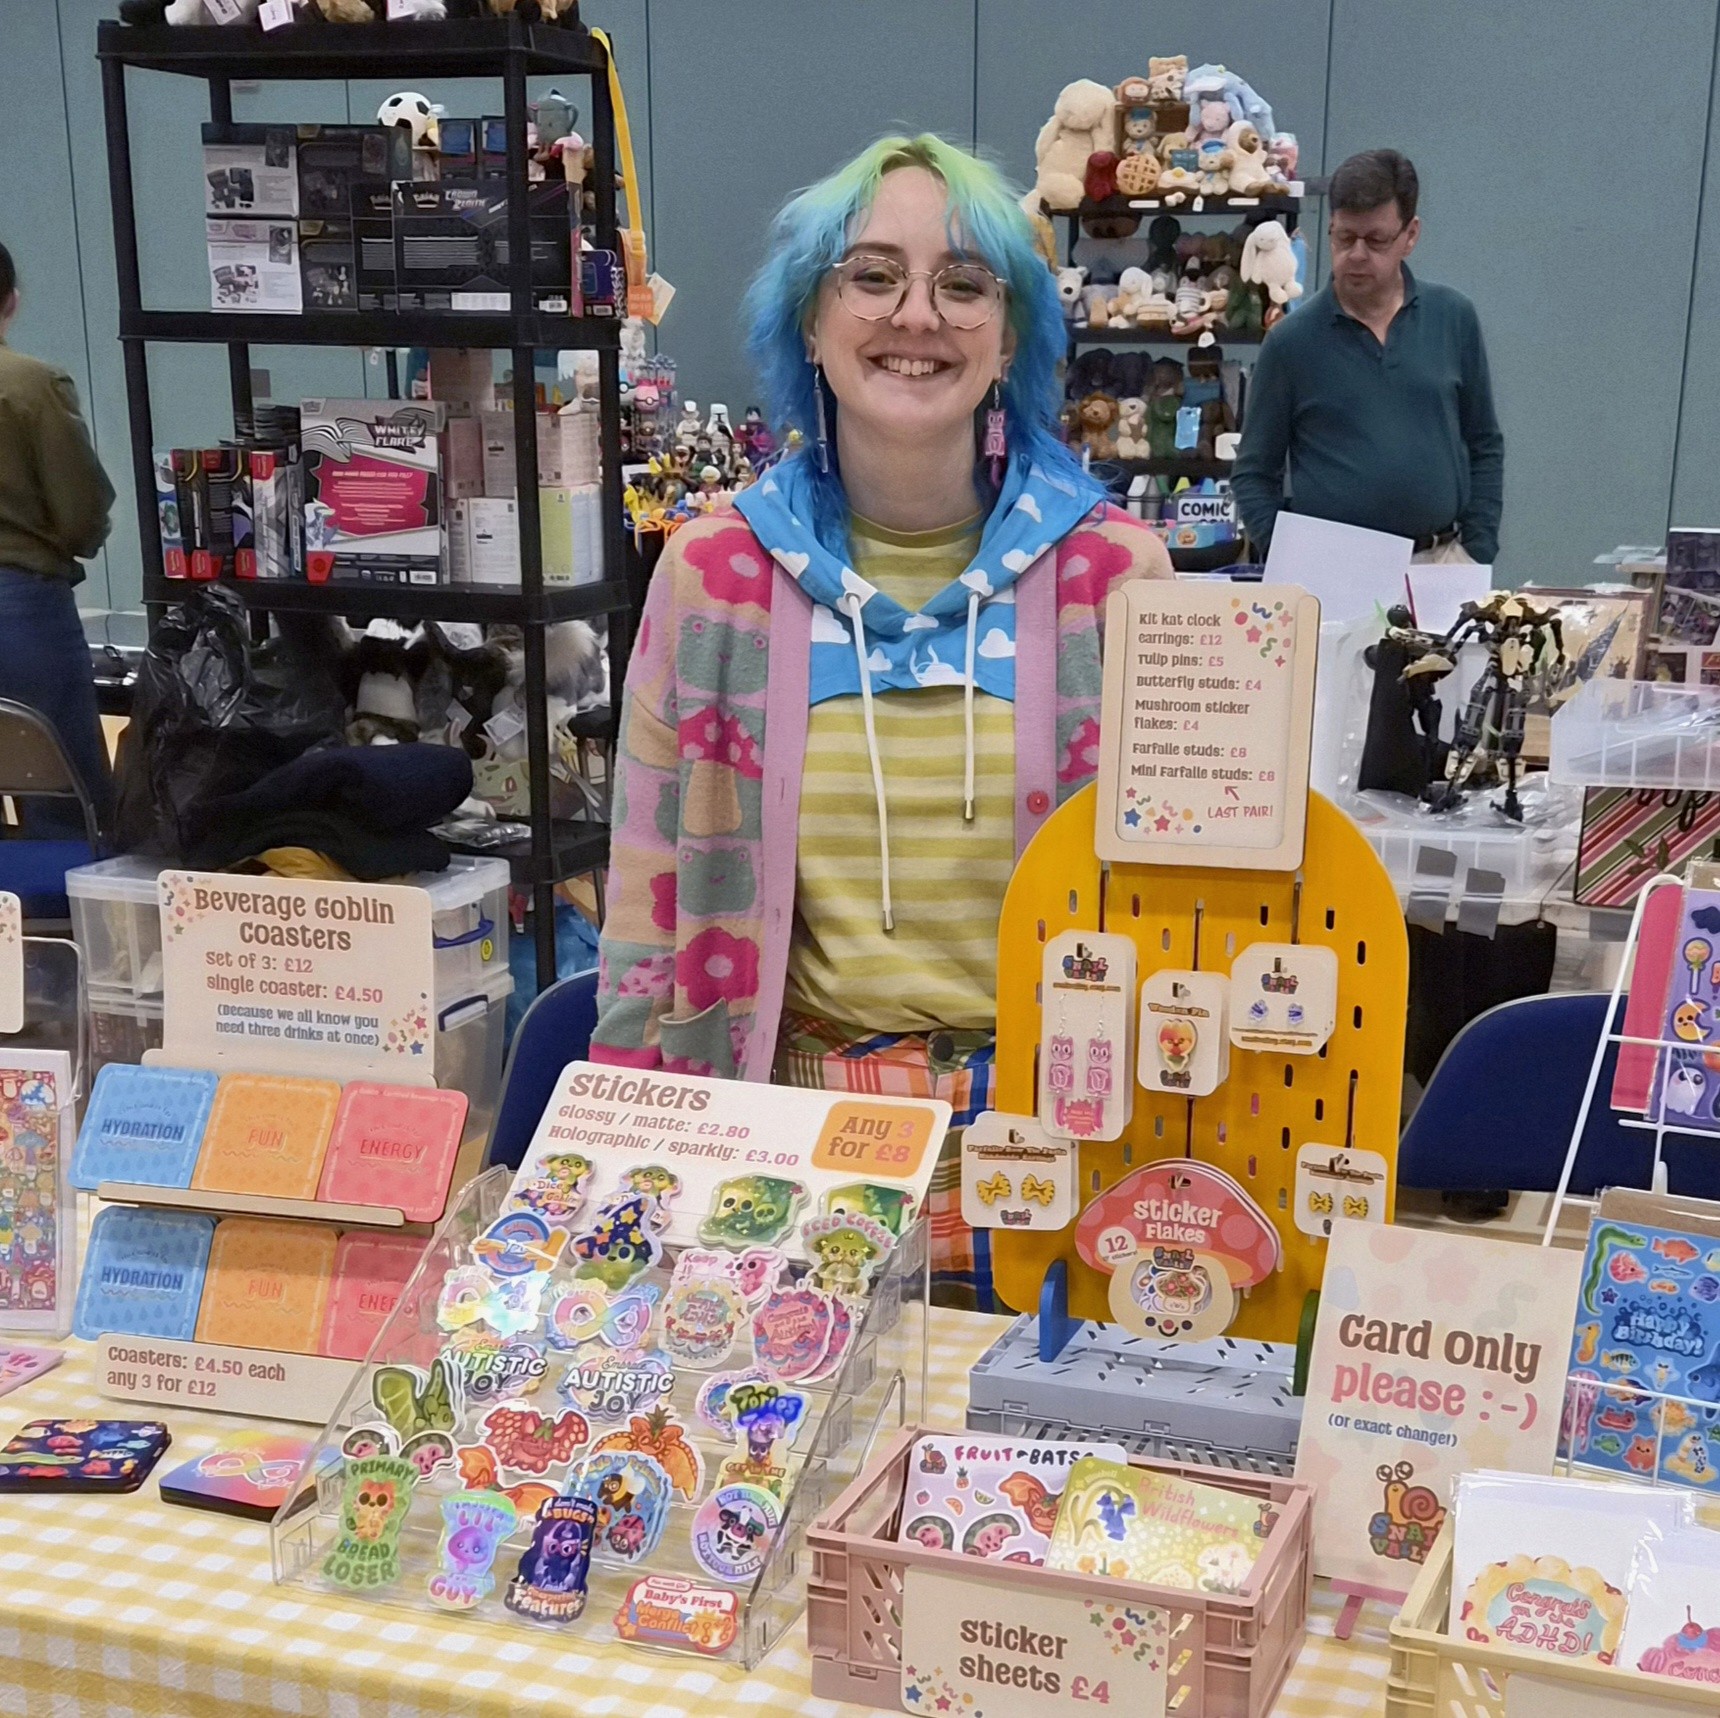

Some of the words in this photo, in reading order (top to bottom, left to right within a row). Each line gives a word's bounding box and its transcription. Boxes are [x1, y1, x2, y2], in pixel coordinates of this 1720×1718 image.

[1181, 502, 1231, 517] COMIC
[1139, 613, 1158, 625] Kit
[1161, 613, 1183, 626] kat
[1187, 613, 1221, 627] clock
[1138, 632, 1194, 647] earrings:
[1200, 635, 1222, 645] £12
[1138, 654, 1168, 667] Tulip
[1172, 653, 1203, 667] pins:
[1208, 656, 1224, 667] £5
[1136, 675, 1195, 690] Butterfly
[1198, 676, 1240, 690] studs:
[1245, 680, 1262, 690] £4
[1134, 699, 1201, 712] Mushroom
[1205, 701, 1250, 714] sticker
[1183, 720, 1199, 731] £4
[1132, 742, 1180, 756] Farfalle
[1183, 744, 1225, 757] studs:
[1230, 747, 1247, 758] £8
[1131, 764, 1157, 777] Mini
[1160, 766, 1208, 779] Farfalle
[1211, 767, 1253, 781] studs:
[1258, 770, 1275, 781] £8
[1207, 806, 1239, 819] LAST
[1243, 805, 1273, 818] PAIR!
[193, 888, 307, 921] Beverage
[315, 895, 395, 924] Goblin
[239, 921, 352, 950] Coasters
[238, 953, 257, 969] of
[261, 955, 277, 970] 3:
[284, 957, 314, 973] £12
[259, 979, 328, 999] coaster:
[335, 985, 383, 1003] £4.50
[277, 1008, 294, 1020] we
[297, 1008, 313, 1023] all
[316, 1009, 350, 1026] know
[354, 1016, 379, 1029] you
[216, 1020, 245, 1034] need
[248, 1021, 281, 1038] three
[284, 1024, 324, 1041] drinks
[327, 1031, 340, 1043] at
[344, 1032, 380, 1046] once)
[568, 1073, 711, 1112] Stickers
[101, 1119, 185, 1141] HYDRATION
[558, 1105, 616, 1126] Glossy
[632, 1114, 692, 1132] matte:
[697, 1122, 750, 1139] £2.80
[840, 1116, 892, 1140] Any
[897, 1121, 916, 1139] 3
[248, 1128, 284, 1147] FUN
[360, 1138, 424, 1160] ENERGY
[548, 1125, 651, 1150] Holographic
[668, 1140, 741, 1161] sparkly:
[745, 1149, 799, 1167] £3.00
[828, 1136, 871, 1160] for
[874, 1145, 910, 1164] £8
[537, 1180, 562, 1191] Dice
[1133, 1199, 1223, 1229] Sticker
[1105, 1235, 1129, 1253] 12
[1145, 1222, 1206, 1244] Flakes
[101, 1266, 184, 1291] HYDRATION
[248, 1279, 284, 1299] FUN
[1338, 1313, 1433, 1360] Card
[1629, 1311, 1691, 1338] Happy
[1613, 1325, 1704, 1356] Birthday!
[107, 1346, 189, 1369] Coasters:
[194, 1356, 243, 1376] £4.50
[248, 1362, 286, 1381] each
[441, 1350, 548, 1375] AUTISTIC
[107, 1370, 138, 1390] any
[141, 1374, 151, 1388] 3
[156, 1373, 182, 1394] for
[187, 1379, 217, 1397] £12
[564, 1368, 675, 1393] AUTISTIC
[1330, 1361, 1467, 1417] please
[588, 1389, 642, 1413] JOY
[1353, 1417, 1393, 1436] exact
[955, 1445, 1013, 1462] FRUIT
[1029, 1447, 1081, 1466] BATS
[351, 1459, 415, 1481] PRIMARY
[1138, 1476, 1196, 1505] British
[458, 1510, 494, 1533] LIL
[1142, 1501, 1239, 1539] Wildflowers
[338, 1538, 391, 1561] BREAD
[322, 1555, 395, 1586] LOSER
[429, 1574, 477, 1605] GUY
[644, 1589, 689, 1605] Baby's
[690, 1595, 723, 1608] First
[636, 1599, 680, 1617] Merge
[960, 1619, 1068, 1660] Sticker
[1496, 1615, 1593, 1655] ADHD!
[959, 1653, 1061, 1694] sheets
[1071, 1676, 1110, 1705] £4
